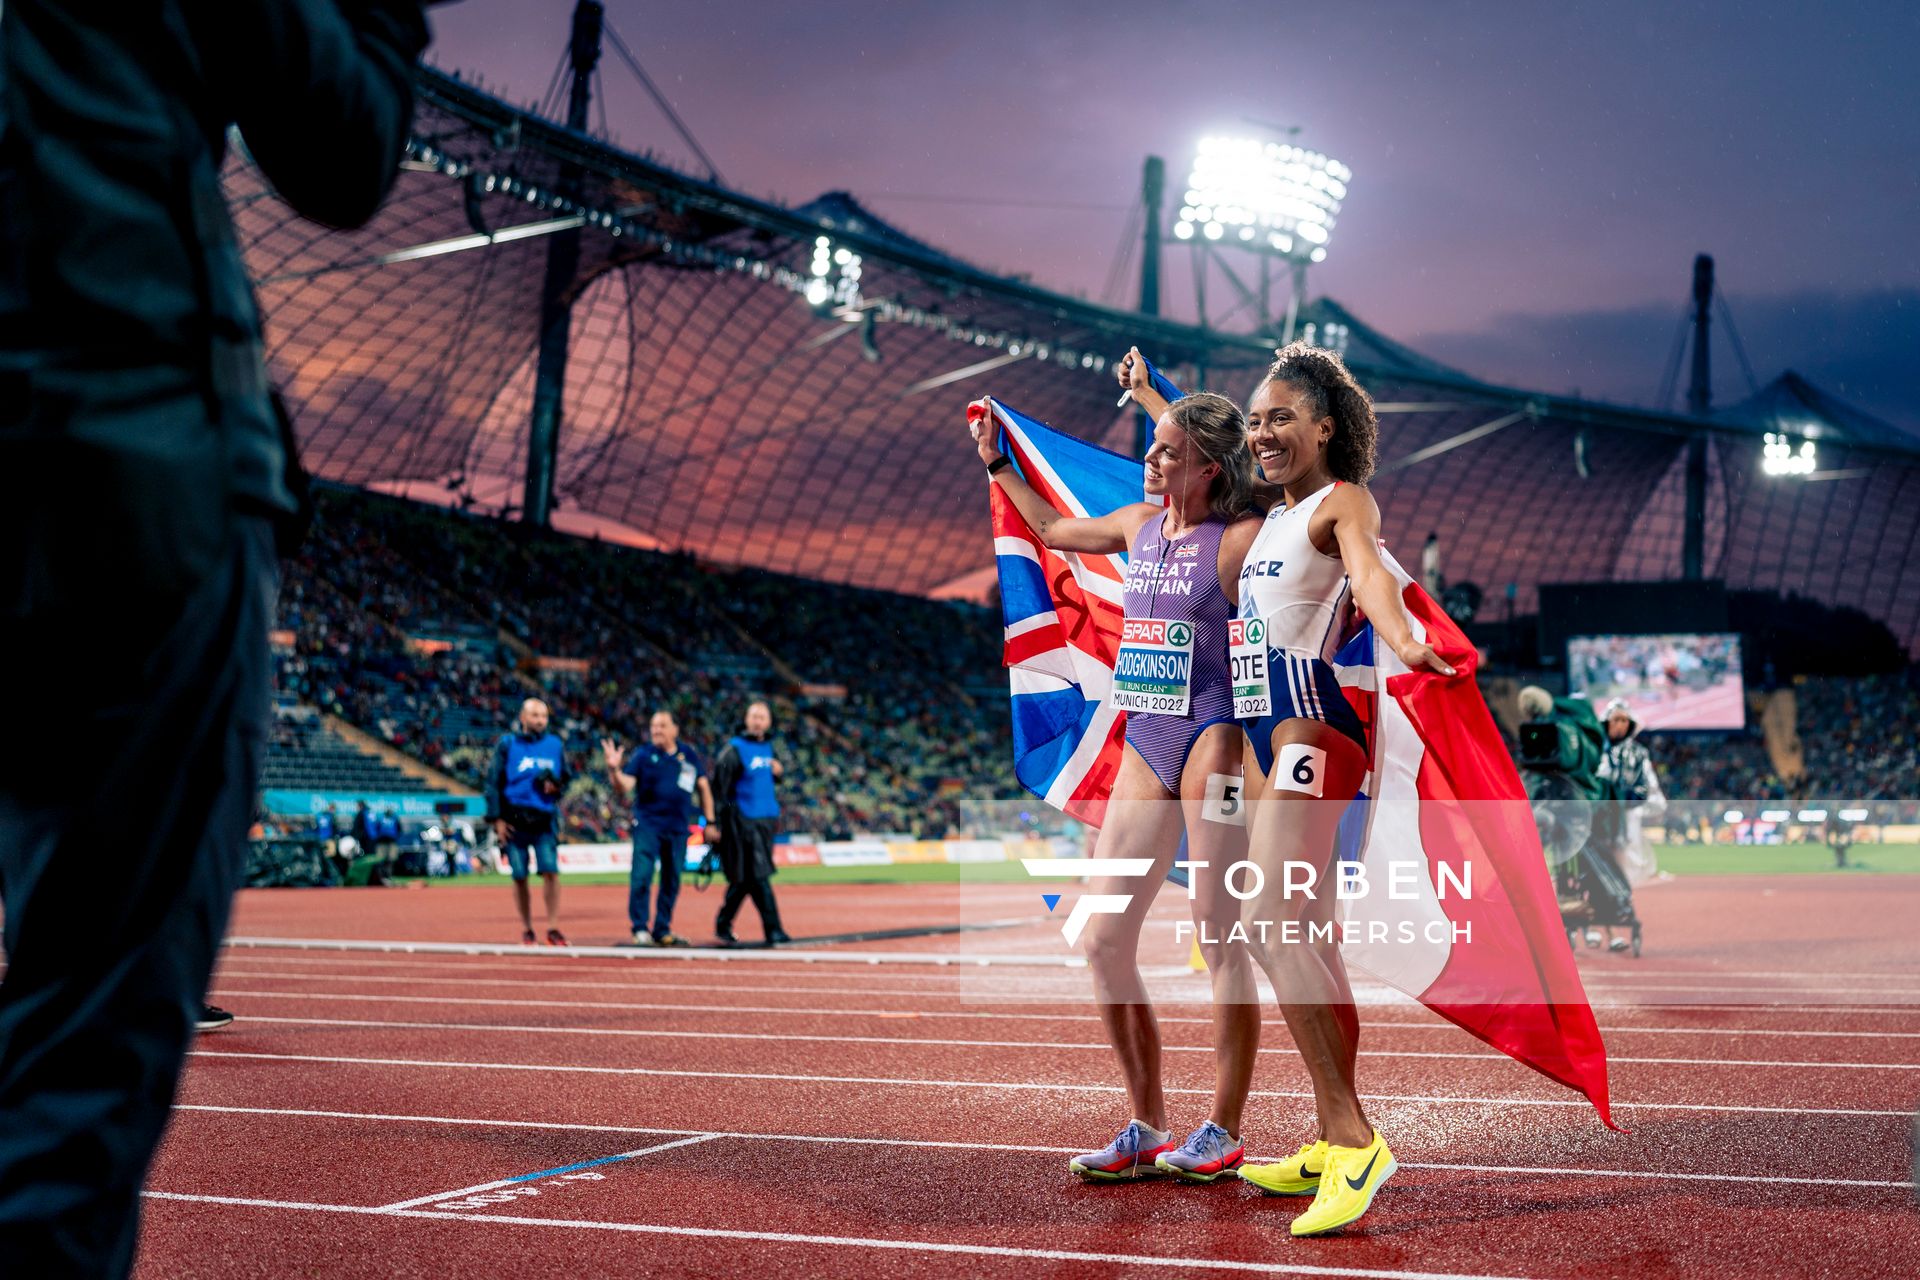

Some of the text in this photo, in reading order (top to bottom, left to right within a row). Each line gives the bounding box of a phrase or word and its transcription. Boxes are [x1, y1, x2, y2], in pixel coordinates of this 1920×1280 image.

[1129, 560, 1197, 577] GREAT
[1124, 578, 1192, 595] BRITAIN
[1123, 623, 1163, 641] SPAR
[1116, 652, 1188, 680] HODGKINSON
[1127, 683, 1140, 691] RUN
[1114, 693, 1184, 711] MUNICH 2022
[1293, 755, 1314, 784] 6
[1221, 786, 1239, 816] 5
